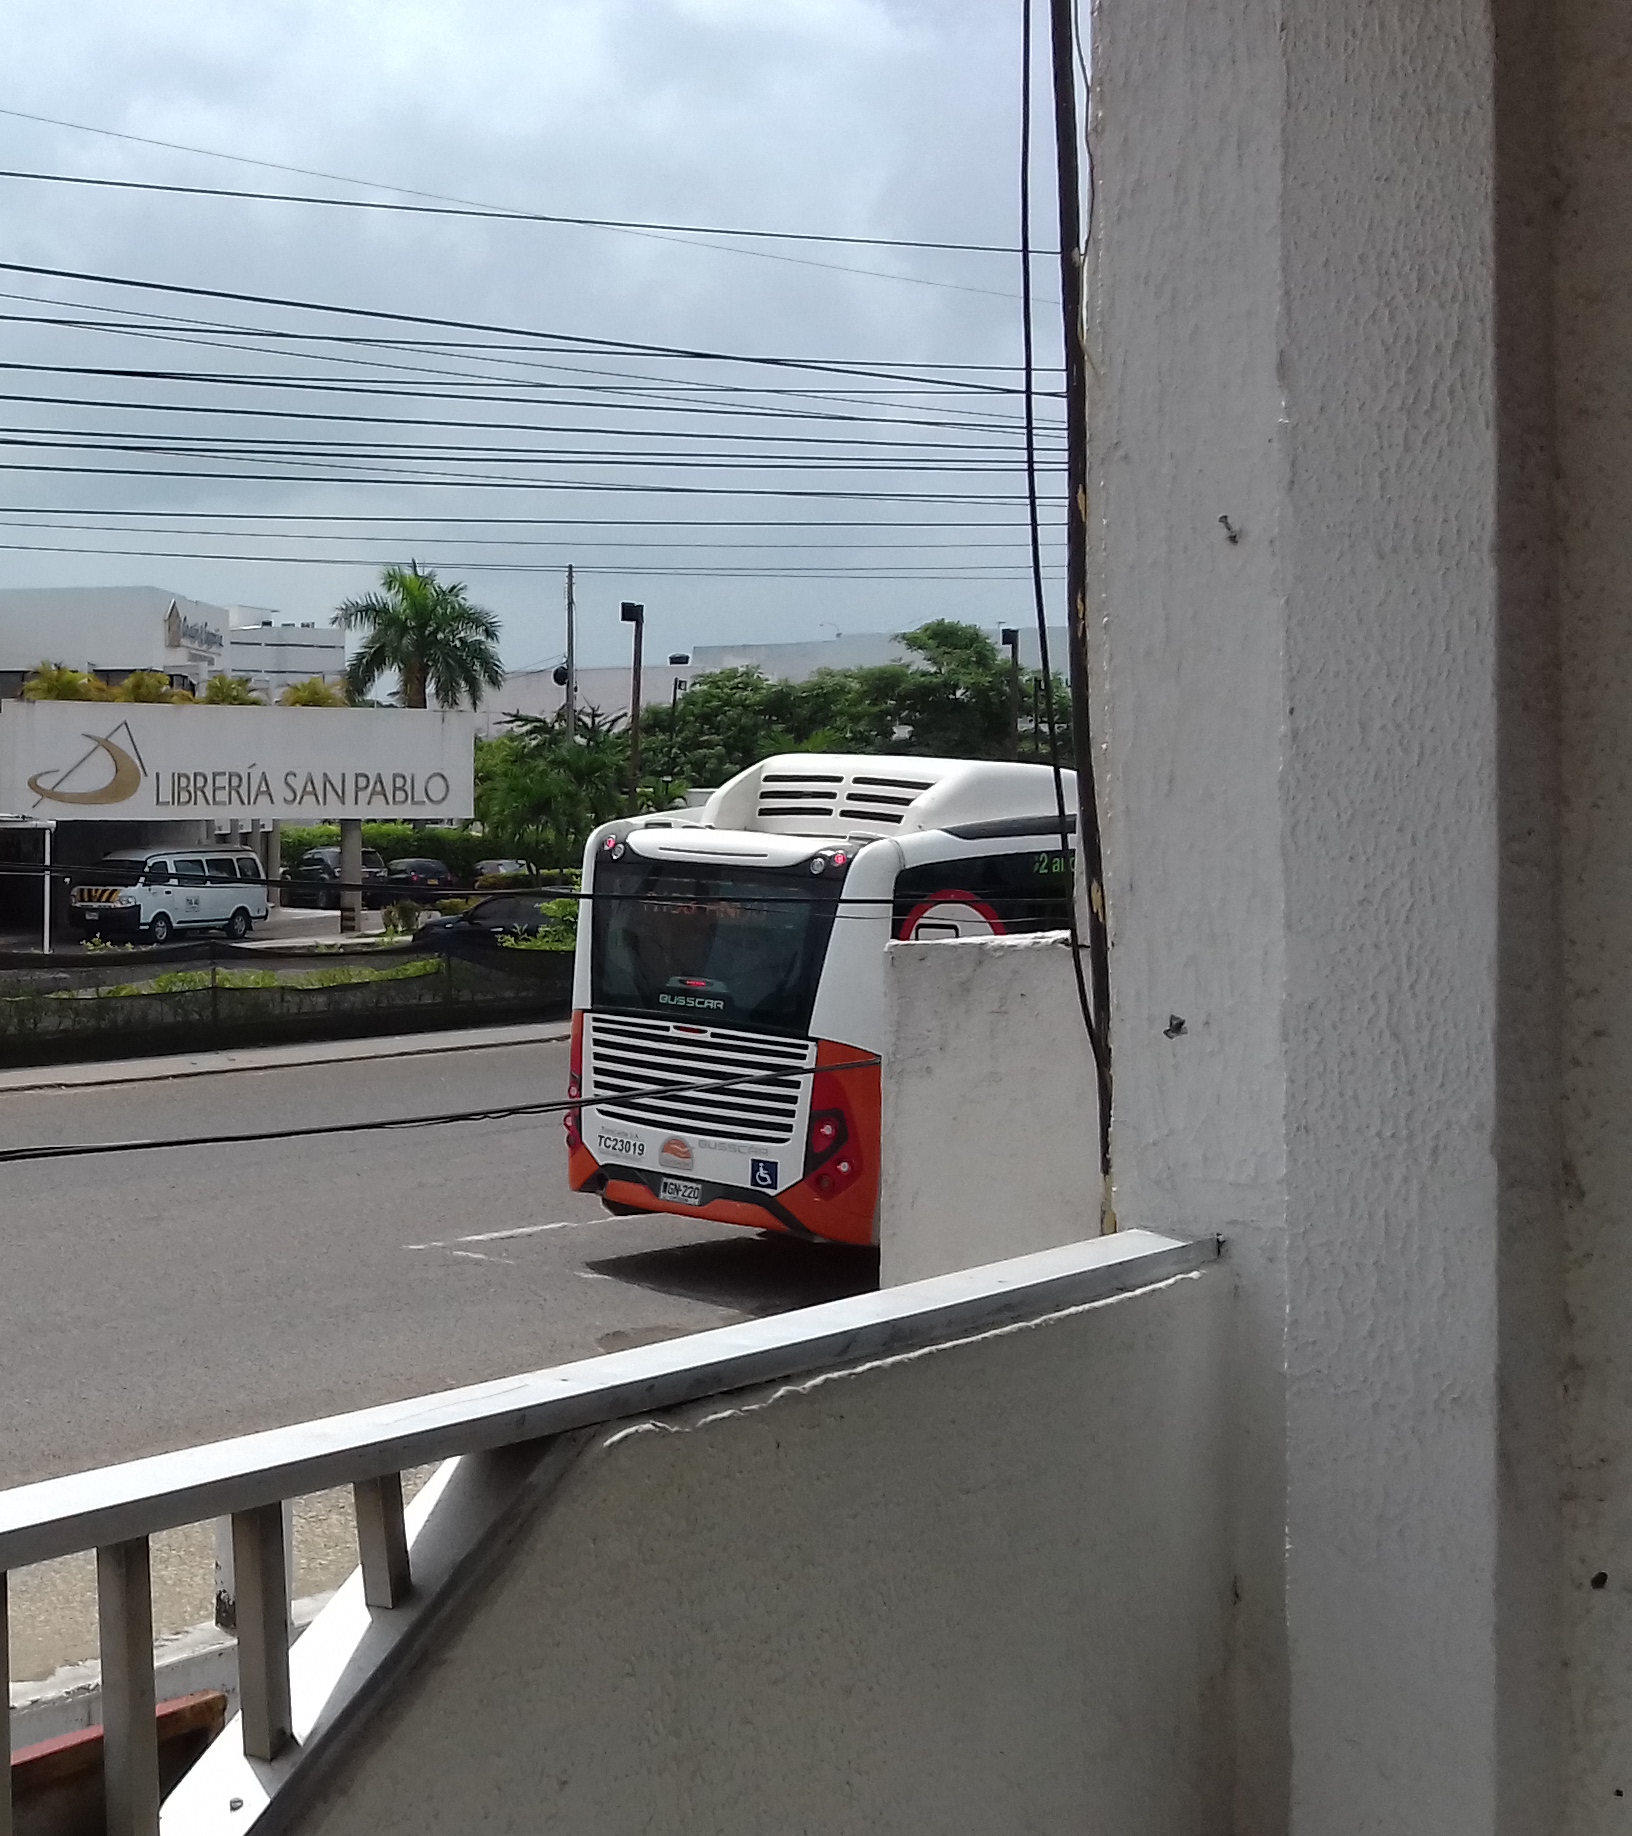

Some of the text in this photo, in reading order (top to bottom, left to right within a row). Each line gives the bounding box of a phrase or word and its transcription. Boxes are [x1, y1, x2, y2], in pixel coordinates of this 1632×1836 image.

[155, 762, 450, 806] LIBRERÍA SAN PABLO
[658, 993, 725, 1010] BUSSCAR
[597, 1134, 645, 1157] TC23019
[698, 1138, 769, 1156] BUSSCAR
